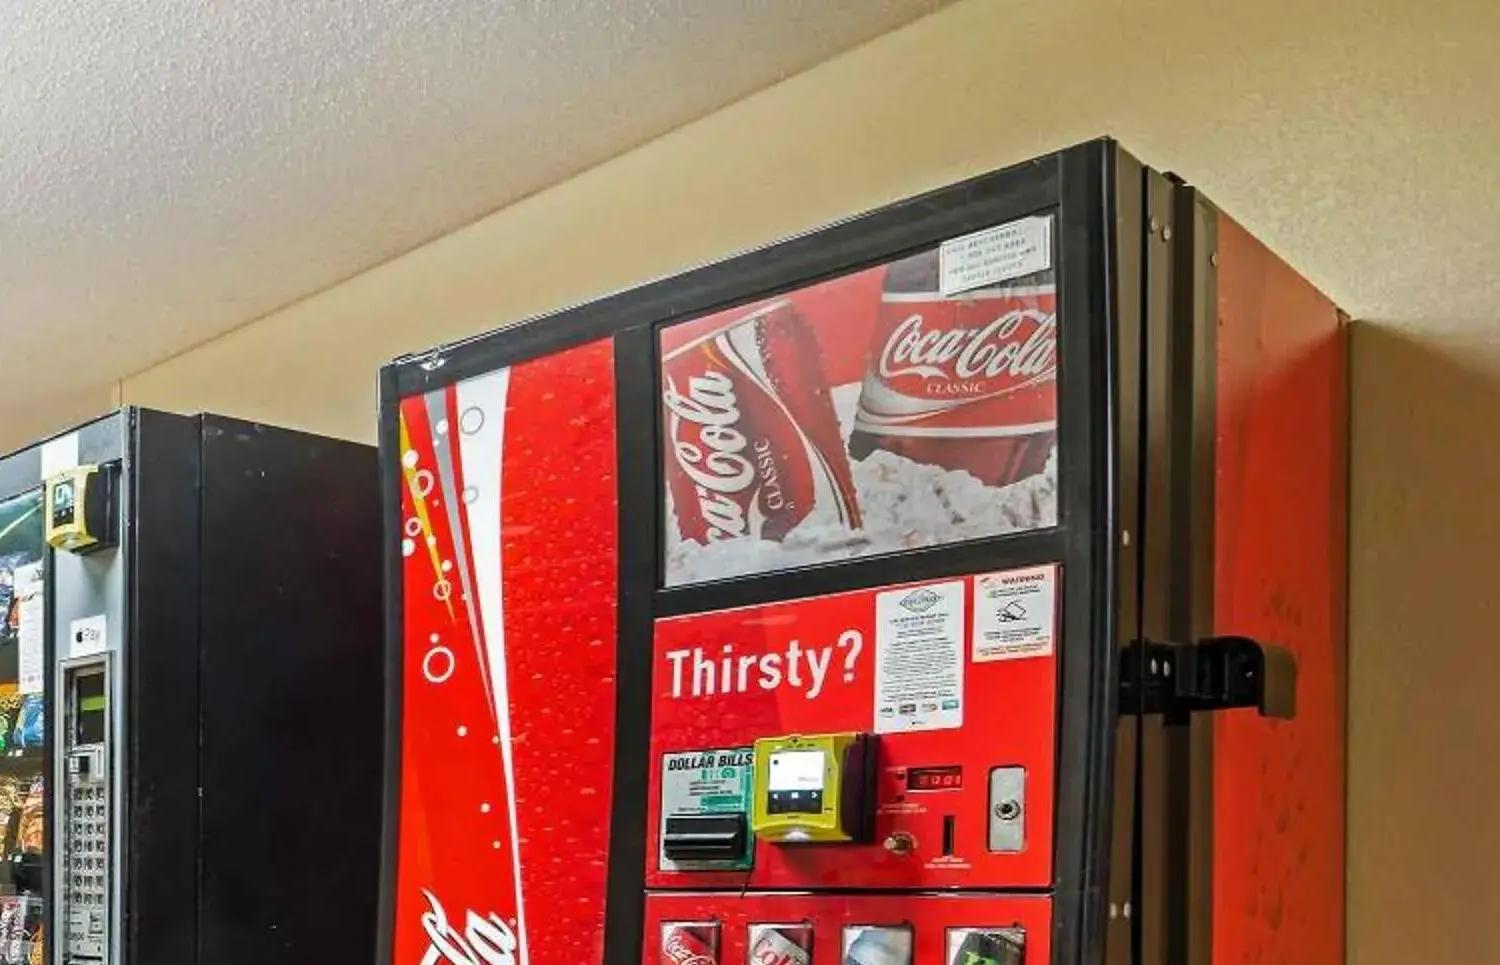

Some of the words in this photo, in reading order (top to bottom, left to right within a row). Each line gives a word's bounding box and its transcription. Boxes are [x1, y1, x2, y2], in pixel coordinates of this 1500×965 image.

[927, 382, 984, 394] CLASSIC
[754, 438, 784, 510] CLASSIC
[665, 629, 864, 700] Thirsty?
[668, 756, 715, 771] DOLLAR
[718, 752, 755, 767] BILLS
